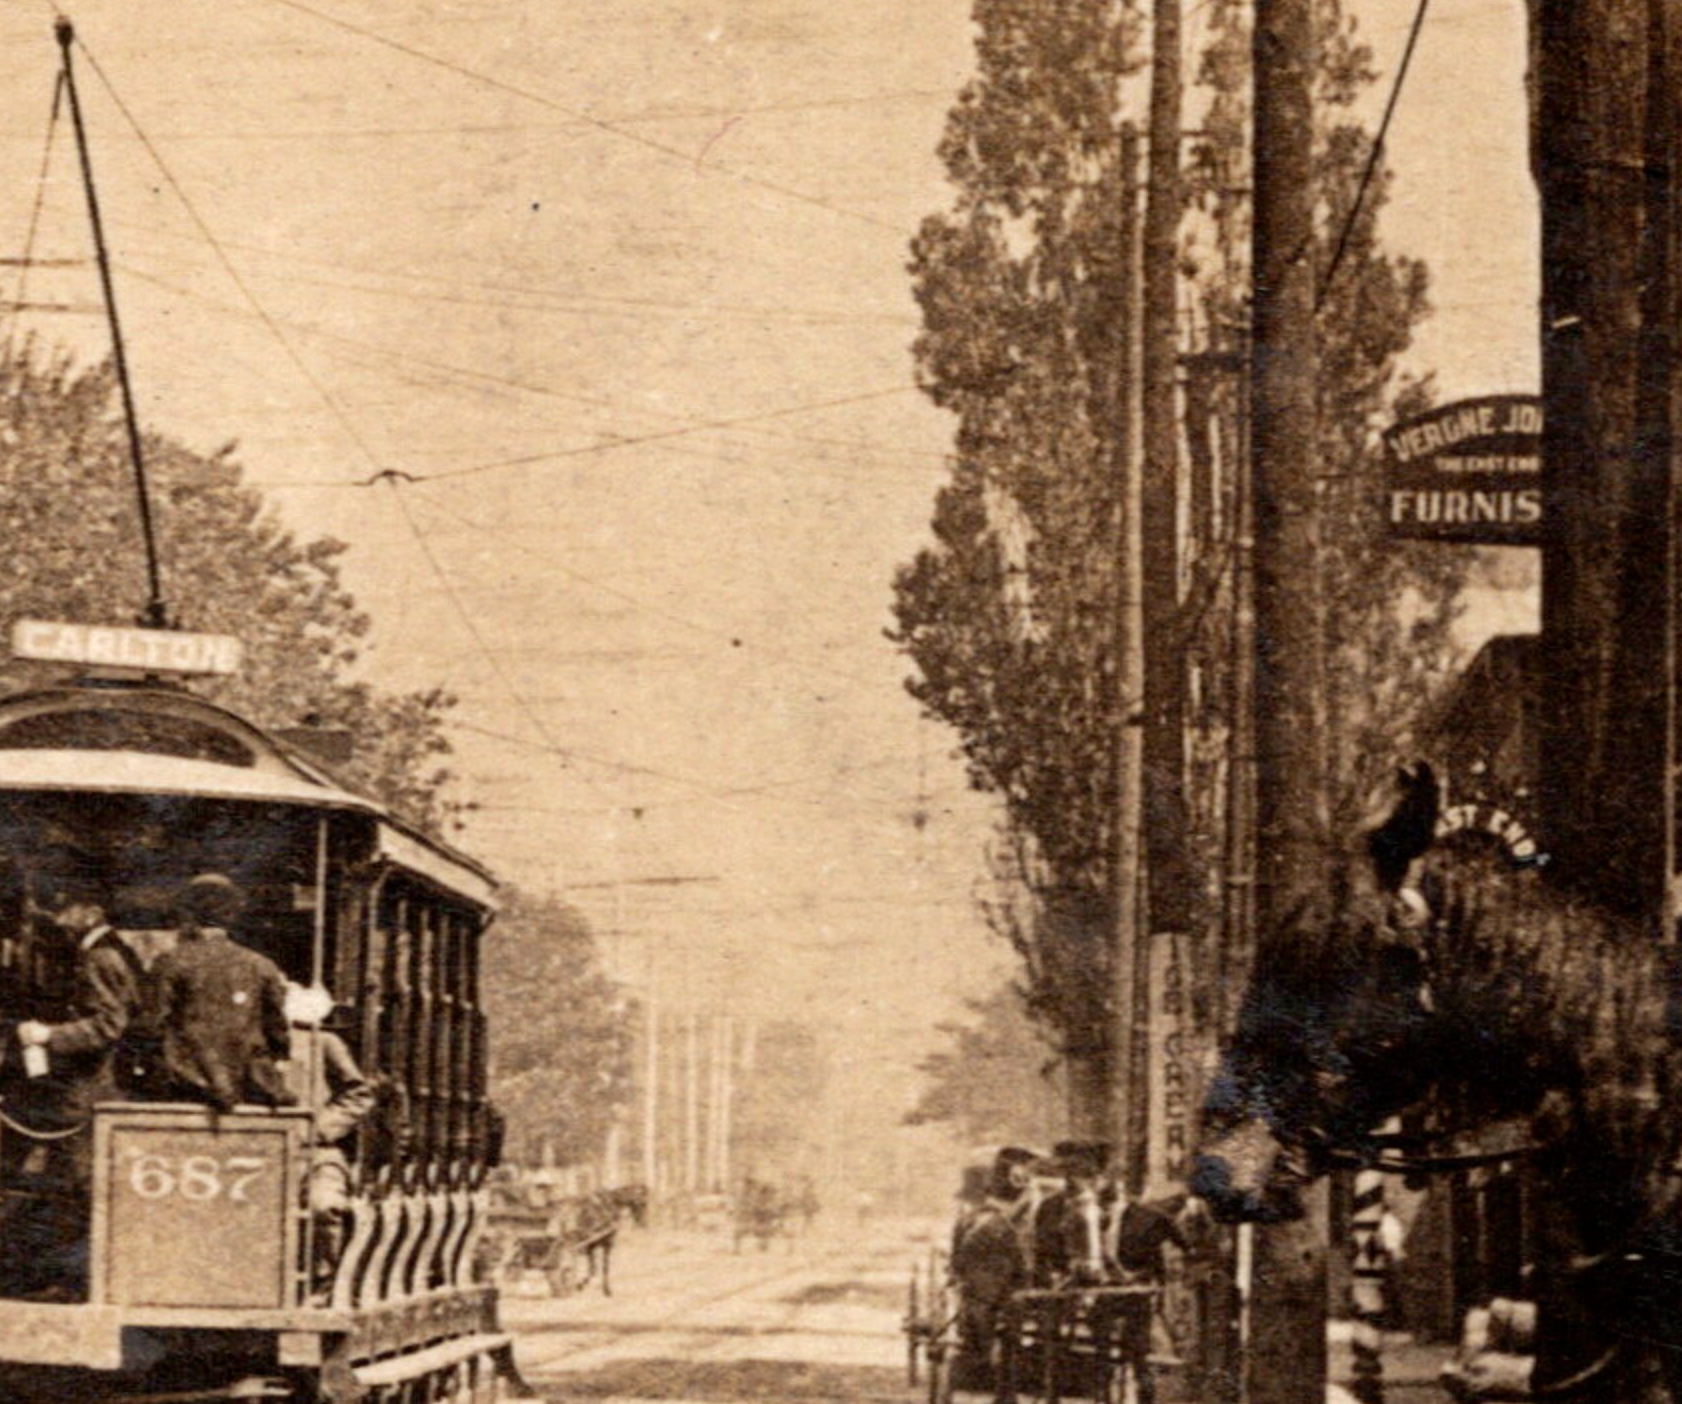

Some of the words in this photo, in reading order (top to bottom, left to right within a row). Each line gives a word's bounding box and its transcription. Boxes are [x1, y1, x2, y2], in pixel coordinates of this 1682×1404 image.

[1390, 489, 1542, 524] FURNIS
[24, 624, 238, 673] CARLTON
[128, 1153, 268, 1203] 687
